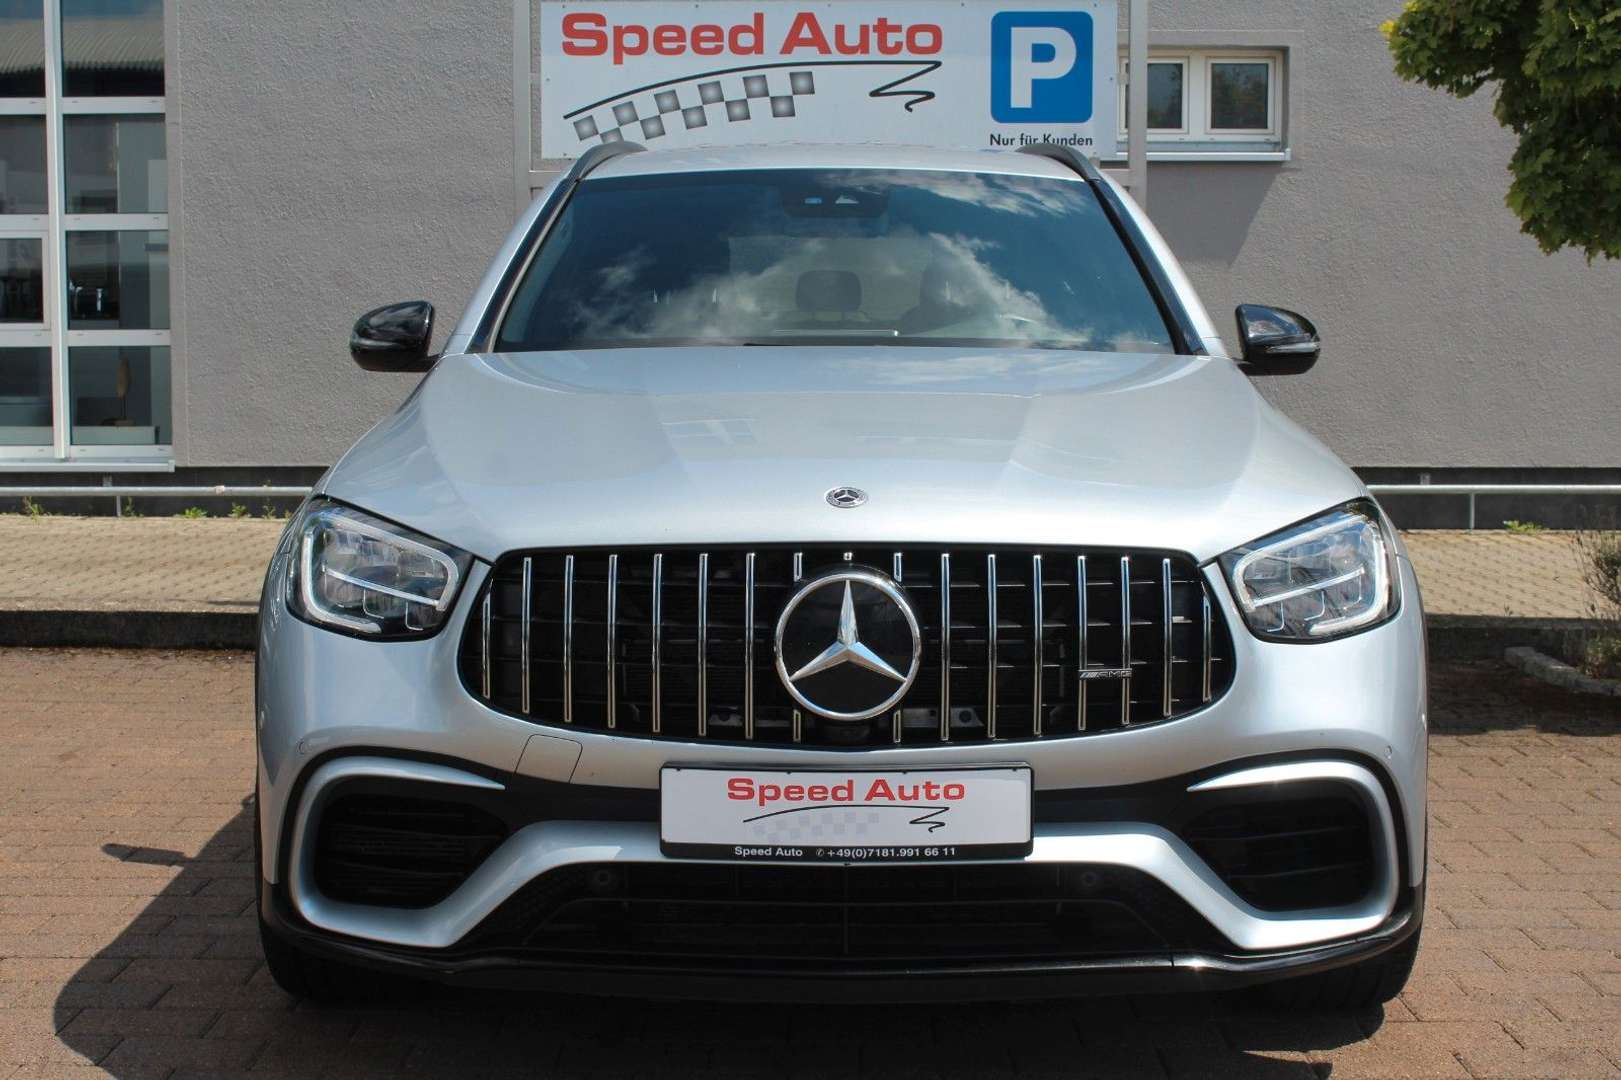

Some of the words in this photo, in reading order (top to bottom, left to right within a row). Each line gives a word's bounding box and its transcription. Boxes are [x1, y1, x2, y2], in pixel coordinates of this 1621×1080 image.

[561, 12, 764, 65] Speed
[780, 12, 943, 56] Auto
[1009, 27, 1077, 109] P
[989, 133, 1016, 147] Nur
[1019, 132, 1039, 146] für
[1043, 132, 1093, 146] Kunden
[727, 777, 854, 806] Speed
[865, 778, 966, 802] Auto
[734, 846, 772, 857] Speed
[775, 847, 803, 857] Auto
[924, 847, 939, 857] 66
[943, 847, 956, 857] 11
